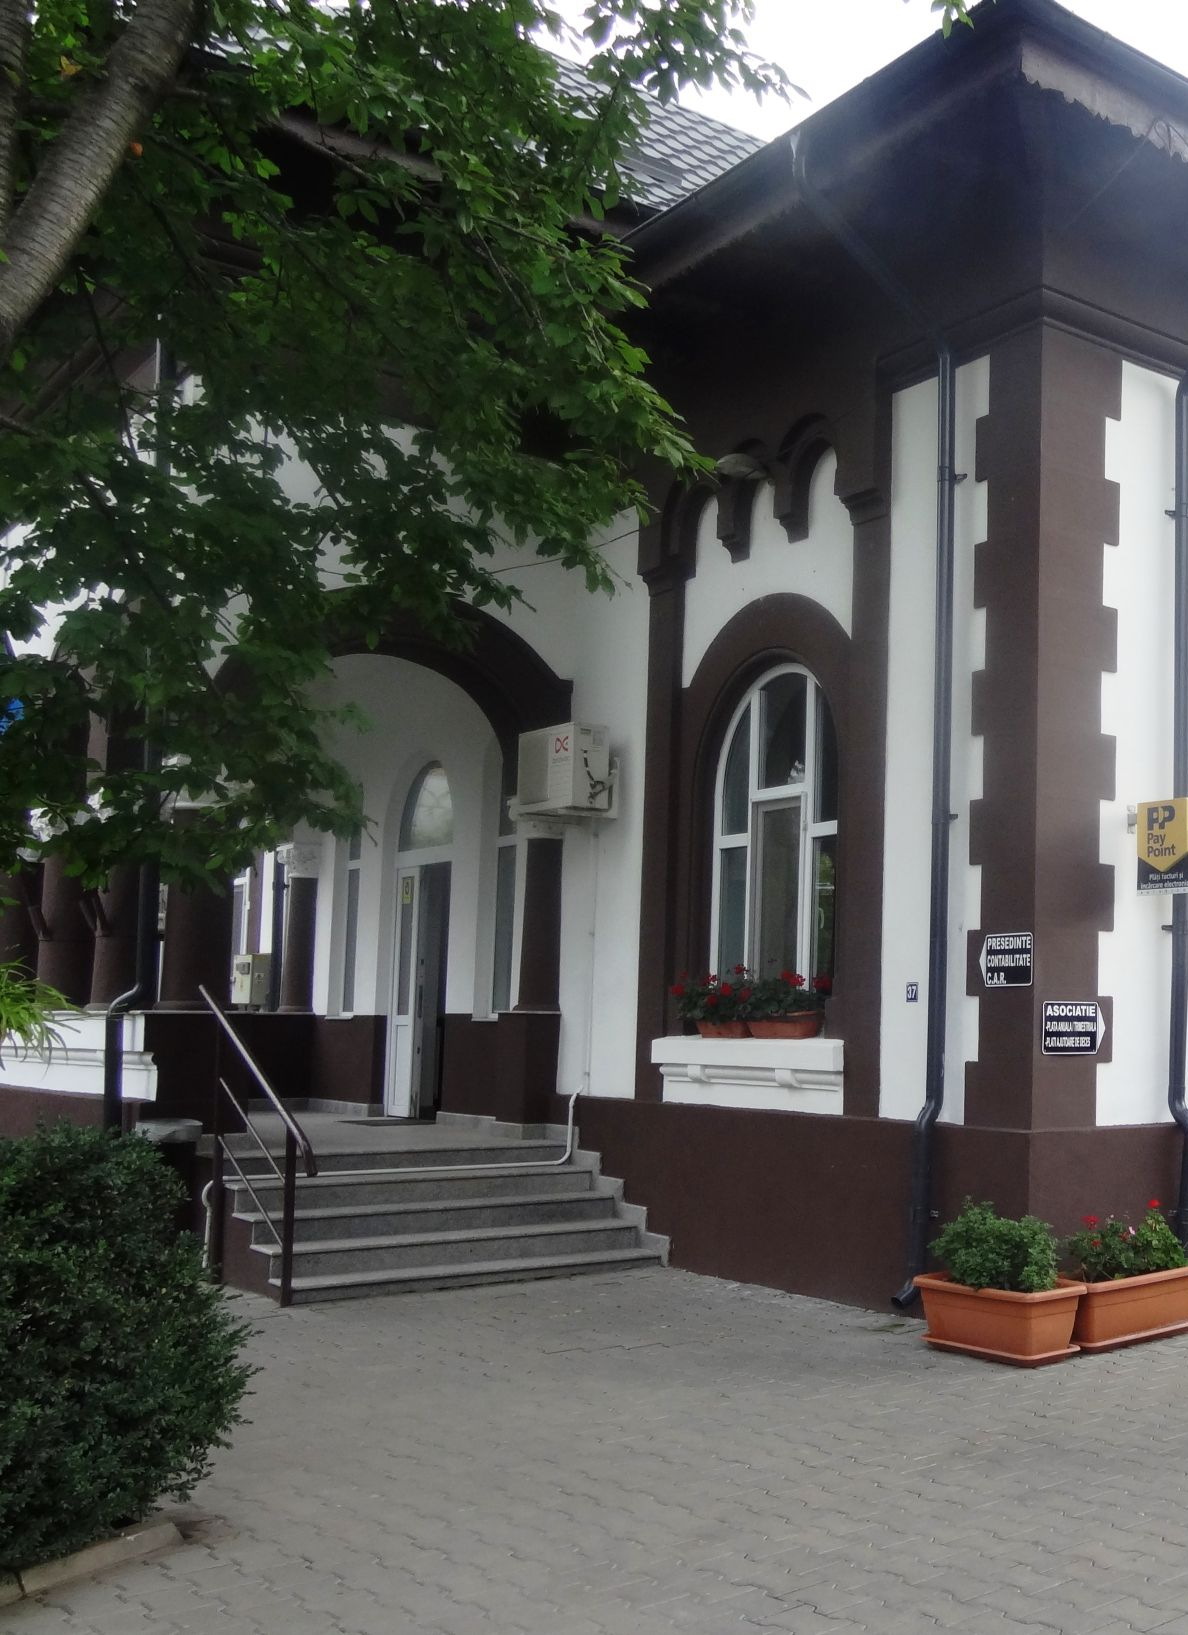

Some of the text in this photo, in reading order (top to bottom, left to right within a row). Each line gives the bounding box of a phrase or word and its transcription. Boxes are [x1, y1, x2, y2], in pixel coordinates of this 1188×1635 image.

[1147, 832, 1166, 847] Pay
[1147, 843, 1176, 858] Point
[987, 936, 1031, 950] PRESEDINTE
[986, 954, 1031, 968] CONTABILITATE
[986, 972, 1007, 985] C.A.R.
[1046, 1005, 1096, 1017] ASOCIATIE
